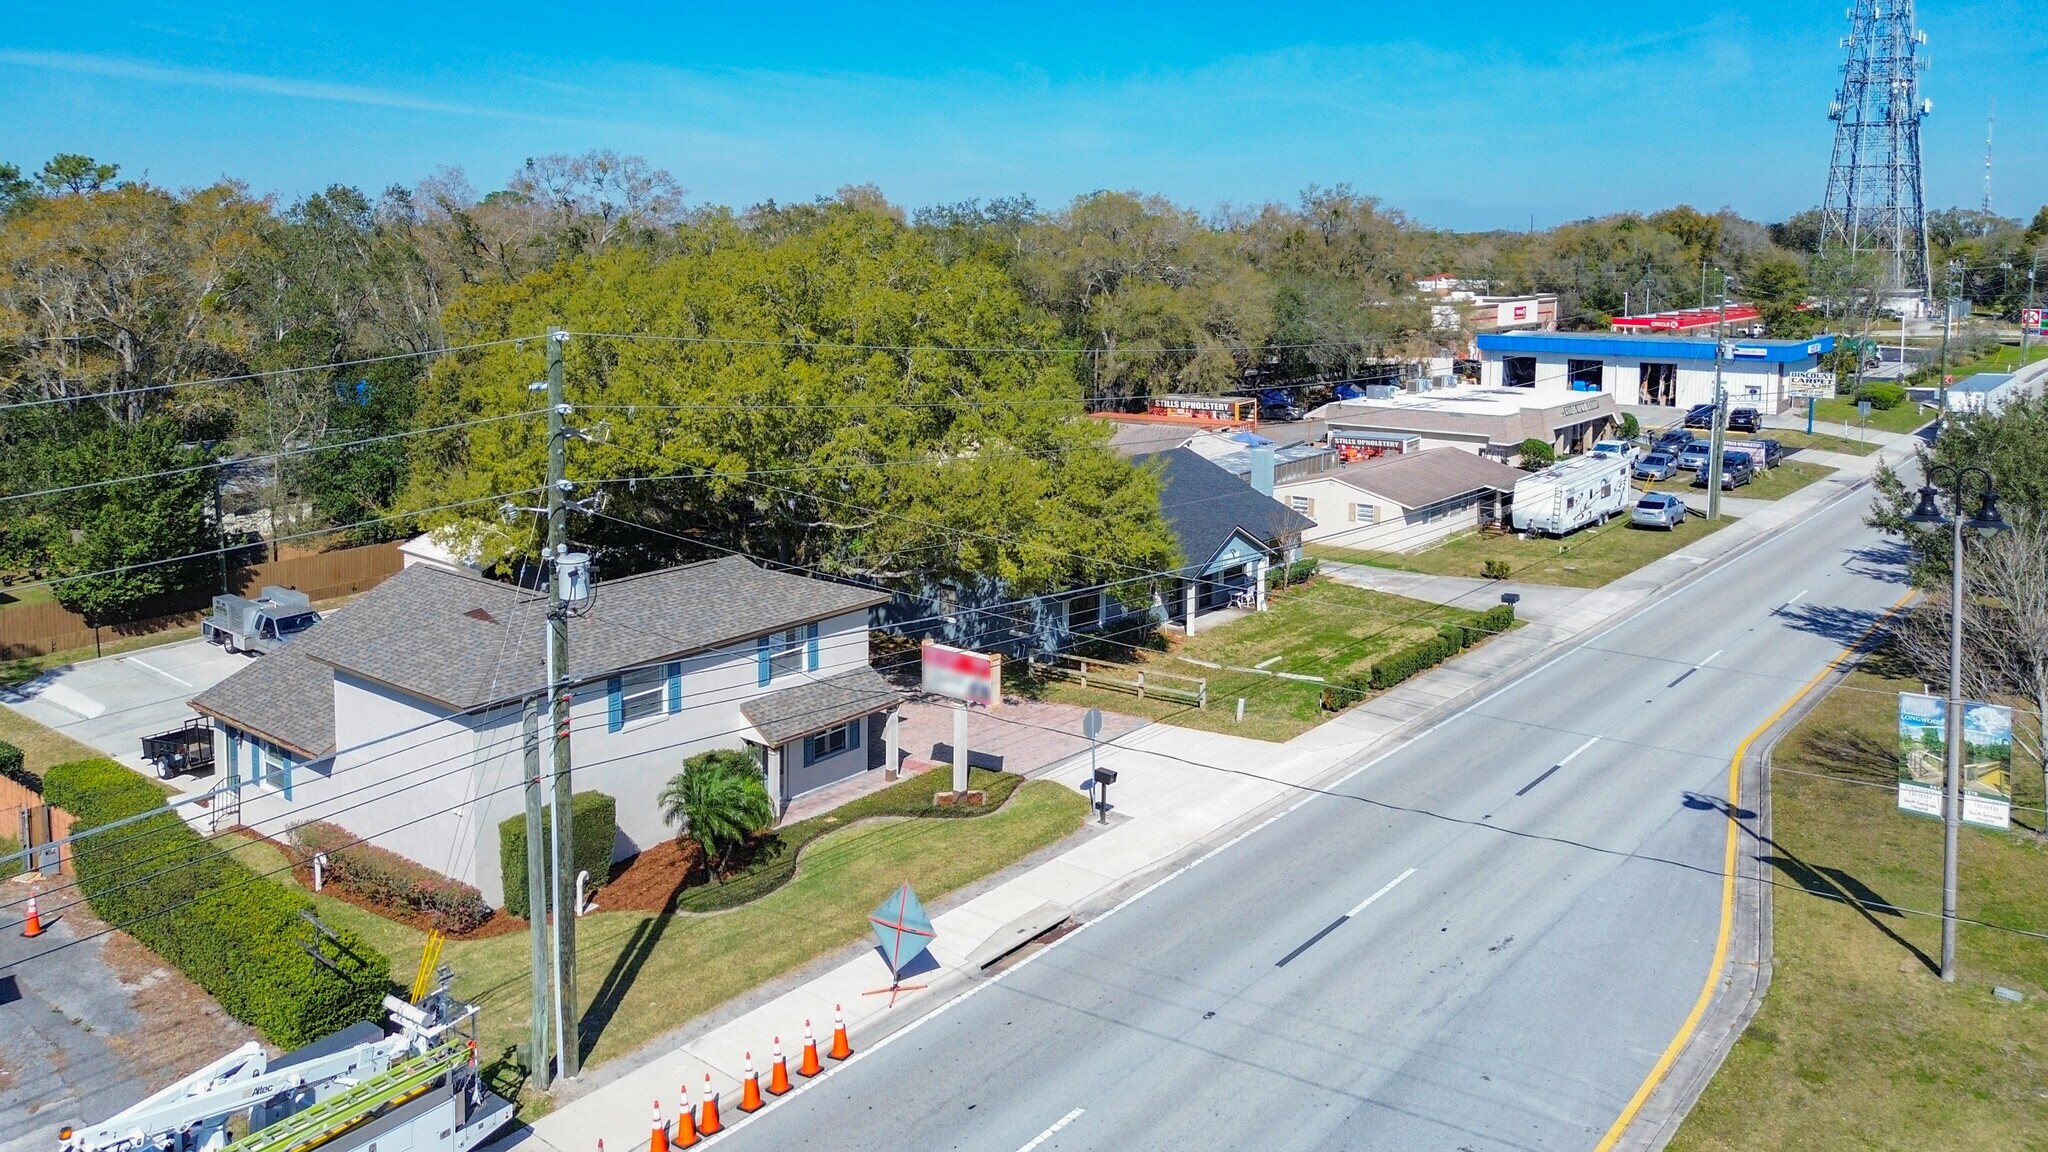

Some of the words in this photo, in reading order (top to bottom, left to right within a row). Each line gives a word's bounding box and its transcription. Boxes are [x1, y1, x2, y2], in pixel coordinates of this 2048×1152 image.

[1155, 400, 1180, 408] STILLS
[1180, 401, 1229, 411] UPHOLSTERY
[1357, 439, 1399, 448] UPHOLSTERY
[1901, 715, 1945, 725] LONGWOOD
[251, 1084, 274, 1097] Altec
